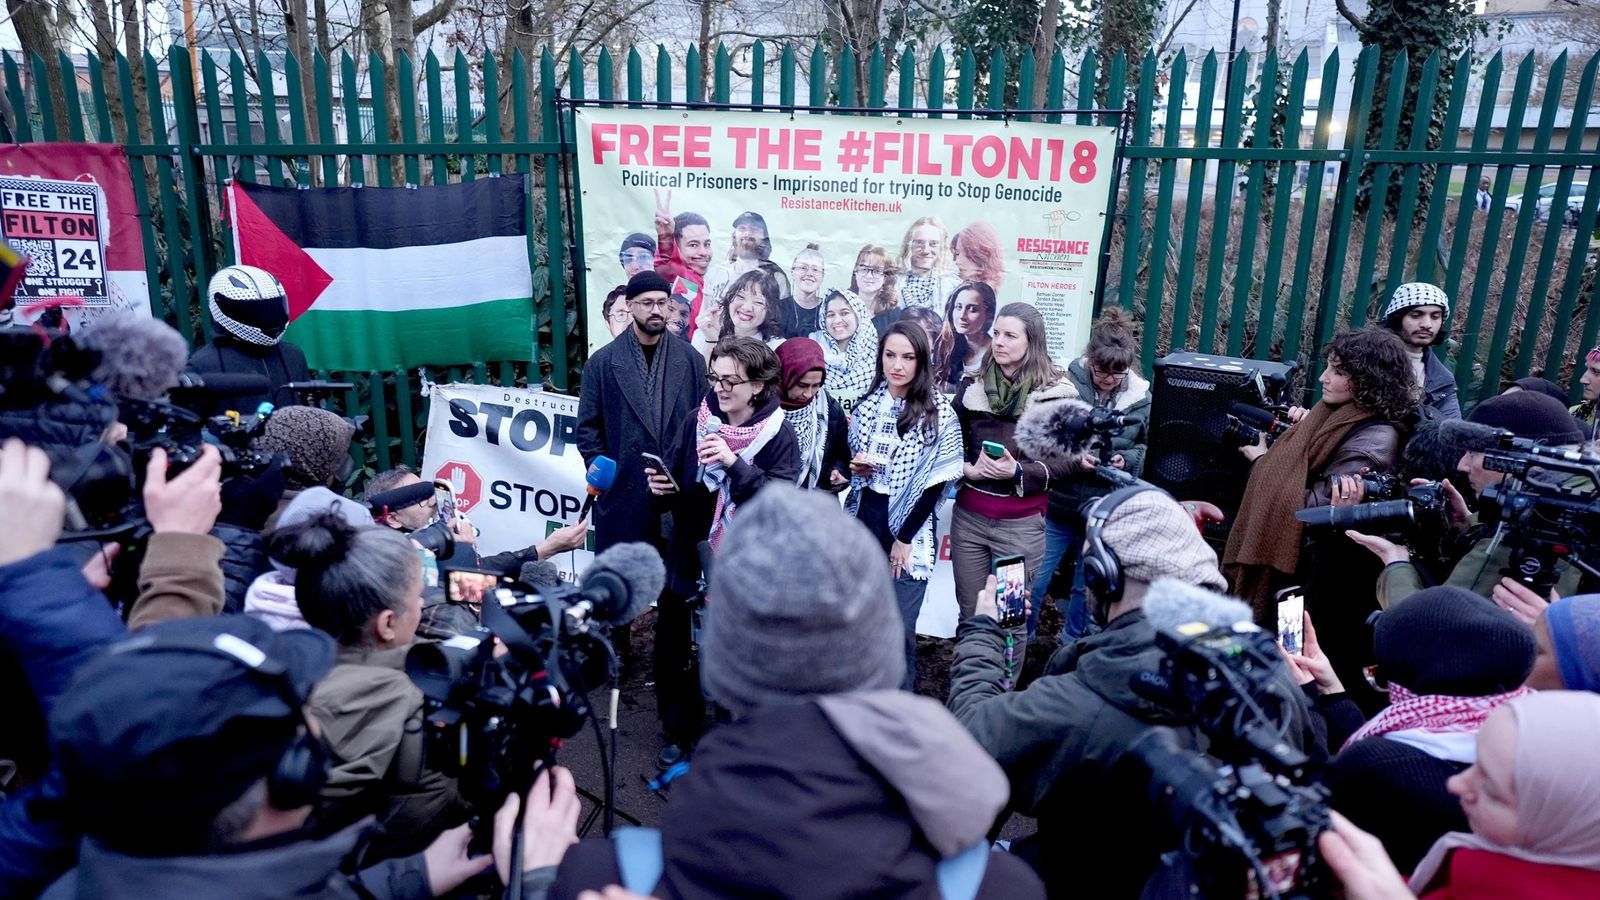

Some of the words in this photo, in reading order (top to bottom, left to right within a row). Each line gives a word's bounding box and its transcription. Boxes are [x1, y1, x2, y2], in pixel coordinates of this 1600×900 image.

[591, 122, 712, 168] FREE
[727, 127, 823, 171] THE
[837, 130, 1098, 184] #FILTON18
[622, 169, 681, 188] Political
[686, 172, 758, 190] Prisoners
[773, 174, 858, 195] Imprisoned
[863, 178, 885, 194] for
[889, 179, 934, 200] trying
[938, 181, 953, 197] to
[957, 181, 990, 202] Stop
[995, 183, 1062, 203] Genocide
[2, 192, 50, 208] FREE
[57, 195, 93, 211] THE
[781, 195, 902, 213] ResistanceKitchen.uk
[5, 213, 95, 237] FILTON
[1017, 237, 1089, 255] RESISTANCE
[61, 248, 97, 270] 24
[24, 277, 45, 286] ONE
[46, 277, 92, 287] STRUGGLE
[1027, 281, 1050, 289] FILTON
[1050, 282, 1077, 290] HEROES
[38, 288, 57, 296] ONE
[60, 288, 85, 296] FIGHT
[1167, 377, 1217, 391] SOUNDBOKS
[503, 393, 574, 412] Destruct
[448, 398, 578, 457] STOP
[456, 497, 471, 508] OP
[489, 480, 581, 520] STOP
